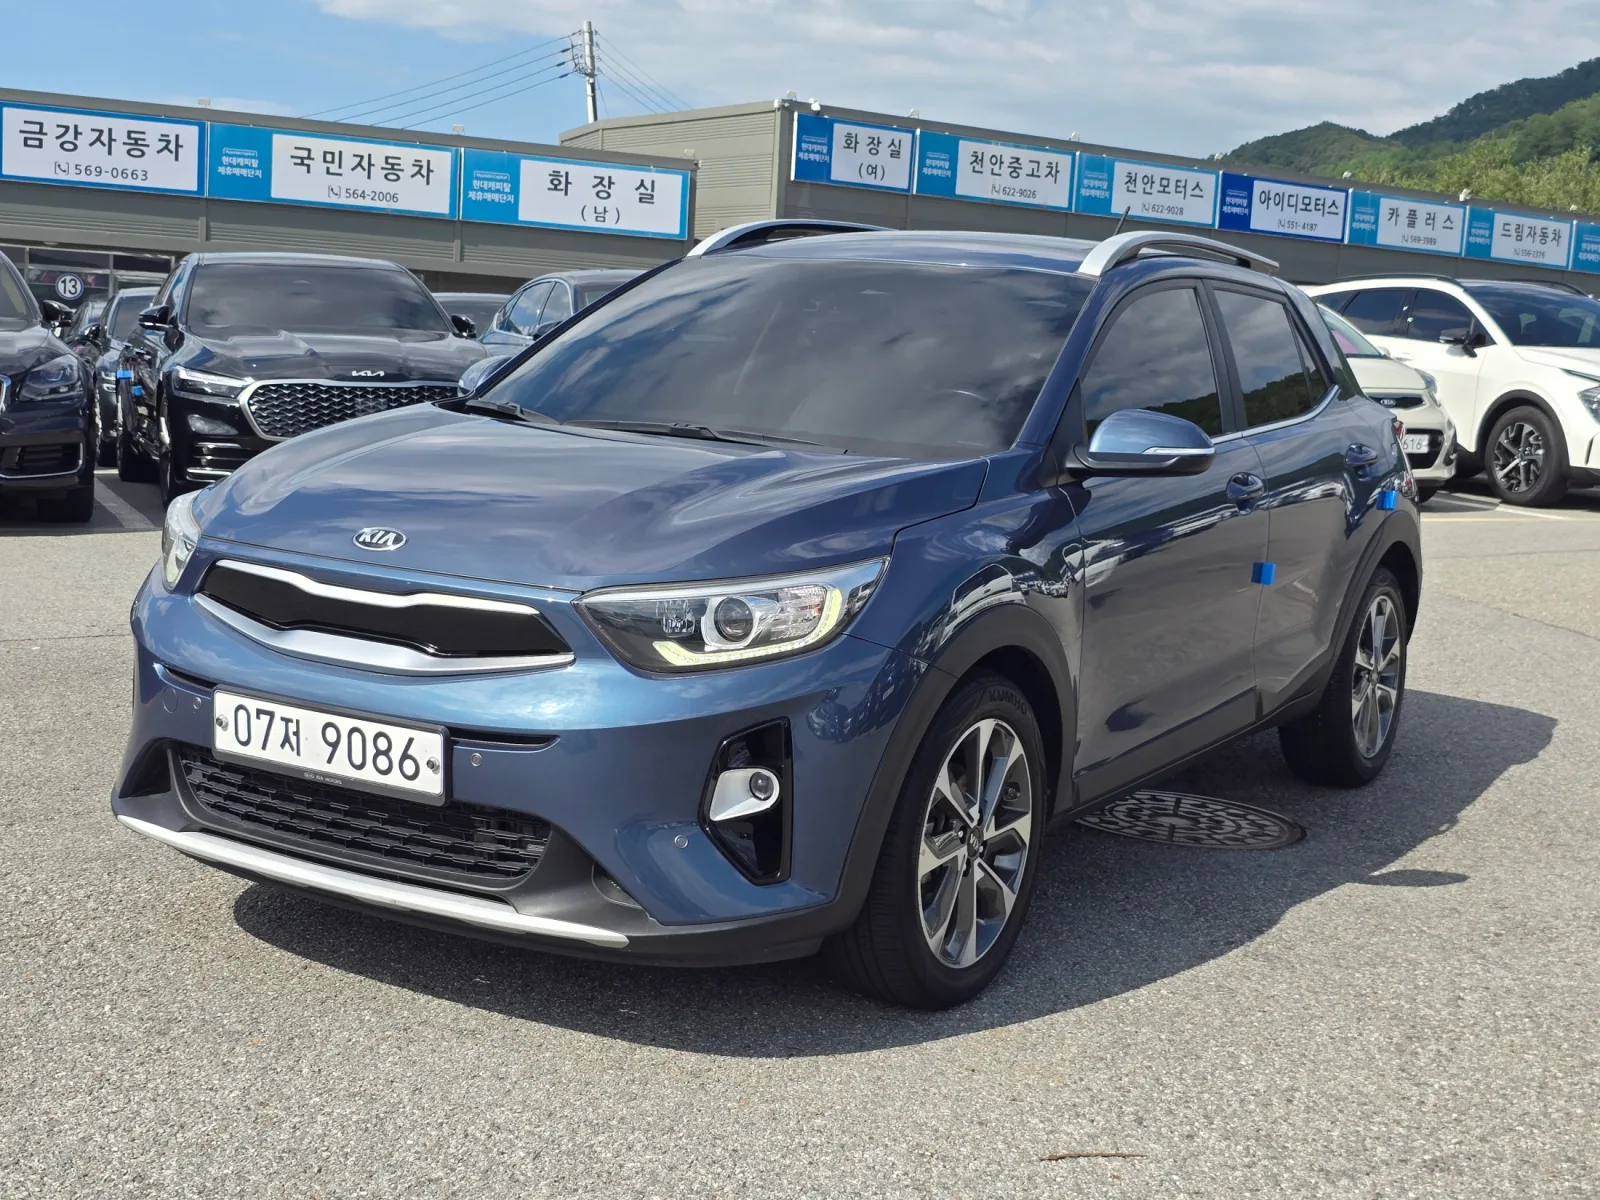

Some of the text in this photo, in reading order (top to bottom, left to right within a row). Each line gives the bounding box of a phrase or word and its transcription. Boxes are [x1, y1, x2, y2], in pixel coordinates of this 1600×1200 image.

[19, 120, 184, 162] 금강자동차
[74, 164, 149, 181] 569-0663
[290, 146, 434, 186] 국민자동차
[858, 162, 886, 181] (여)
[969, 150, 1060, 184] 천안중고차
[472, 180, 511, 193] 현대캐피탈
[1002, 186, 1037, 199] 622-9026
[1124, 171, 1204, 200] 천안모터스
[345, 188, 399, 203] 564-2006
[1259, 189, 1339, 217] 아이디모터스
[1151, 203, 1184, 216] 622-9028
[1286, 220, 1318, 232] 551-4187
[1500, 222, 1562, 247] 드림자동차
[61, 278, 78, 295] 13
[358, 529, 397, 546] KIA
[989, 688, 1028, 715] KUMHO
[234, 704, 421, 782] 07저 9086
